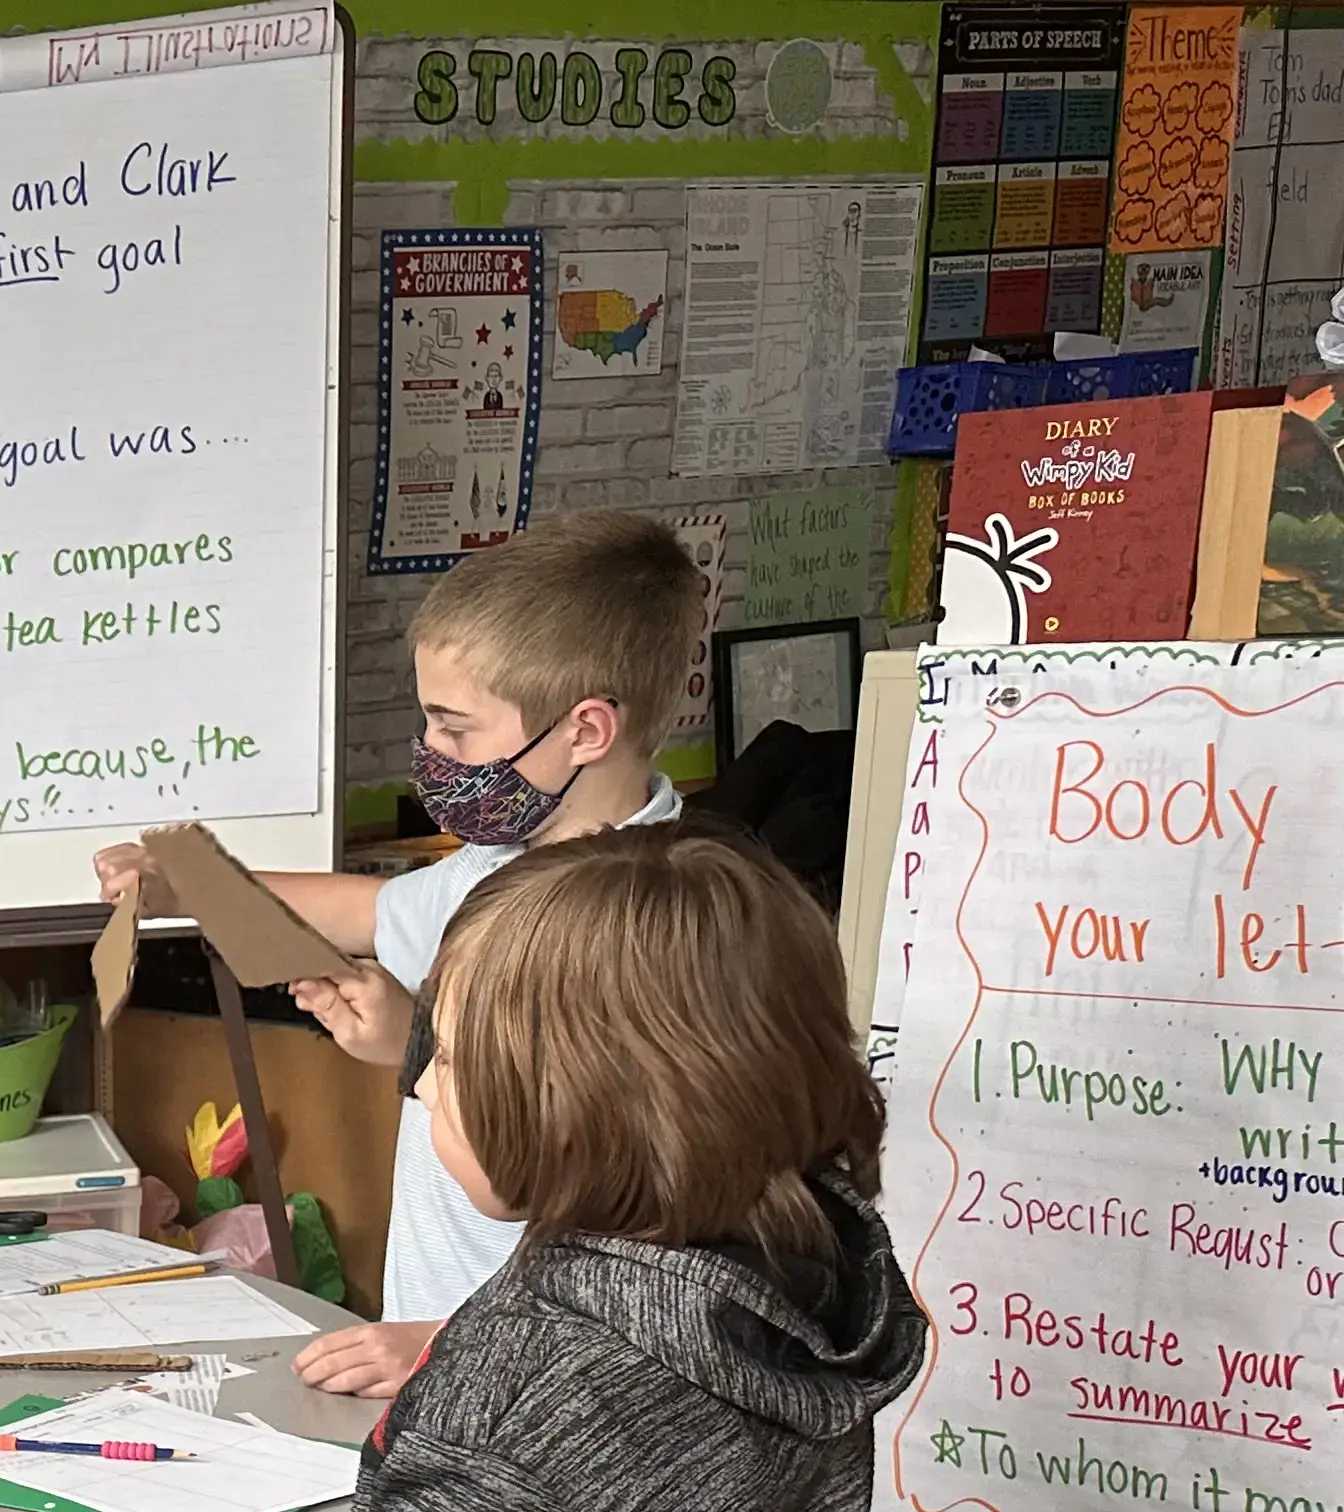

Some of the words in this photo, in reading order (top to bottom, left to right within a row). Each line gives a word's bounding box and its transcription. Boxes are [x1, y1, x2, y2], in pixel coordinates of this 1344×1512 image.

[968, 31, 1018, 50] PARTS
[1023, 30, 1043, 48] OF
[1047, 29, 1102, 49] SPEECH
[1142, 16, 1219, 63] Theme
[414, 48, 737, 129] STUDIES
[962, 77, 988, 89] Noun
[12, 162, 88, 210] and
[121, 142, 237, 197] Clark
[946, 169, 987, 182] Pronoun
[1012, 166, 1043, 179] Article
[97, 225, 182, 295] goal
[421, 253, 491, 275] BRANCHES
[493, 253, 509, 271] OF
[932, 259, 985, 274] Preposition
[992, 255, 1047, 270] Conjunction
[1153, 266, 1178, 282] MAIN
[1180, 265, 1204, 280] IDEA
[414, 272, 511, 294] GOVERNMENT
[1045, 416, 1120, 441] DIARY
[1062, 440, 1081, 458] of
[1082, 446, 1095, 457] a
[1021, 457, 1095, 490] Wimpy
[1094, 449, 1136, 482] Kid
[1028, 495, 1054, 509] BOX
[1060, 492, 1076, 506] OF
[1080, 489, 1125, 506] BOOKS
[53, 532, 234, 579] compares
[4, 611, 63, 652] tea
[82, 601, 222, 648] kettles
[191, 724, 262, 768] the
[1049, 740, 1279, 892] Body
[1035, 901, 1151, 977] your
[1010, 1040, 1184, 1121] Purpose:
[1221, 1037, 1323, 1103] WHY
[1002, 1181, 1150, 1238] Specific
[1004, 1291, 1185, 1368] Restate
[1217, 1344, 1305, 1398] your
[989, 1356, 1032, 1401] to
[1075, 1376, 1312, 1444] summarize
[967, 1426, 1018, 1481] To
[1036, 1436, 1169, 1502] whom
